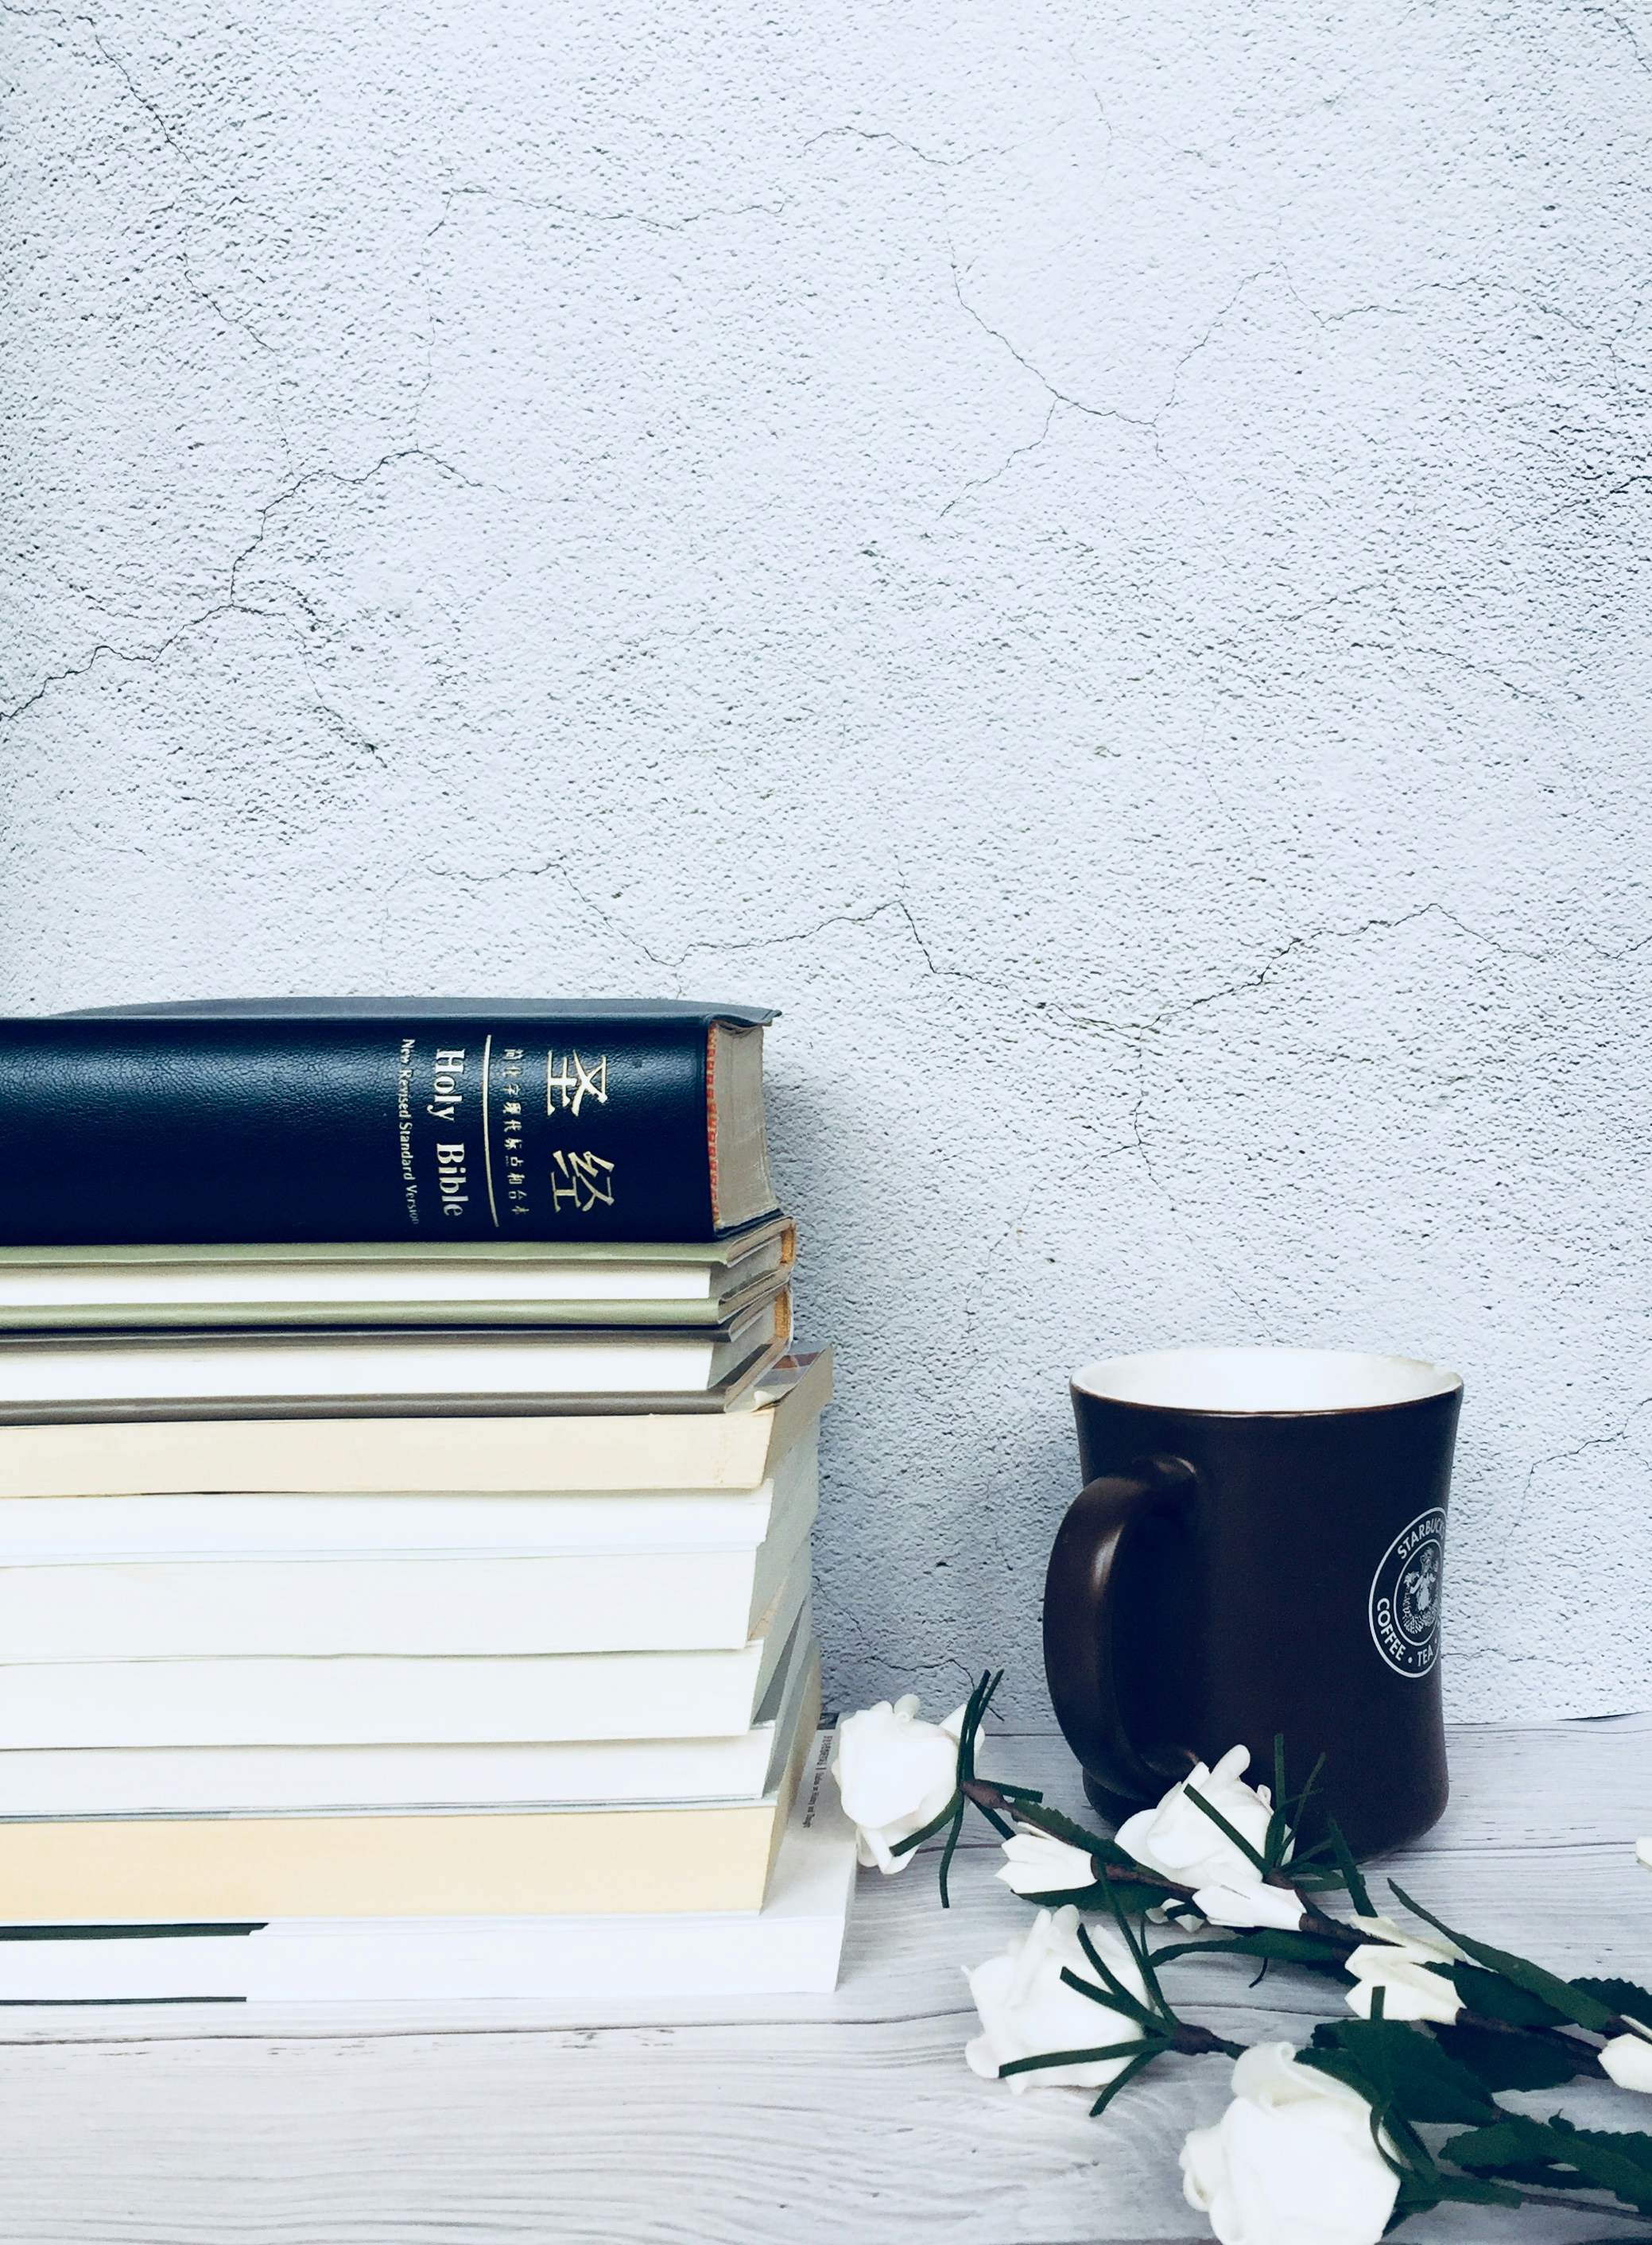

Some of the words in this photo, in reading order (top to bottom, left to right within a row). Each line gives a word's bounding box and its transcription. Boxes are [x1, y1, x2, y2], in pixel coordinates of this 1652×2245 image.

[400, 1039, 415, 1064] New
[398, 1069, 412, 1119] Revised
[427, 1049, 465, 1121] Holy
[399, 1122, 416, 1181] Standard
[547, 1049, 615, 1213] 圣经
[405, 1185, 419, 1224] Version
[436, 1142, 469, 1216] Bible
[1377, 1598, 1406, 1661] COFFEE
[1417, 1645, 1433, 1667] TEA
